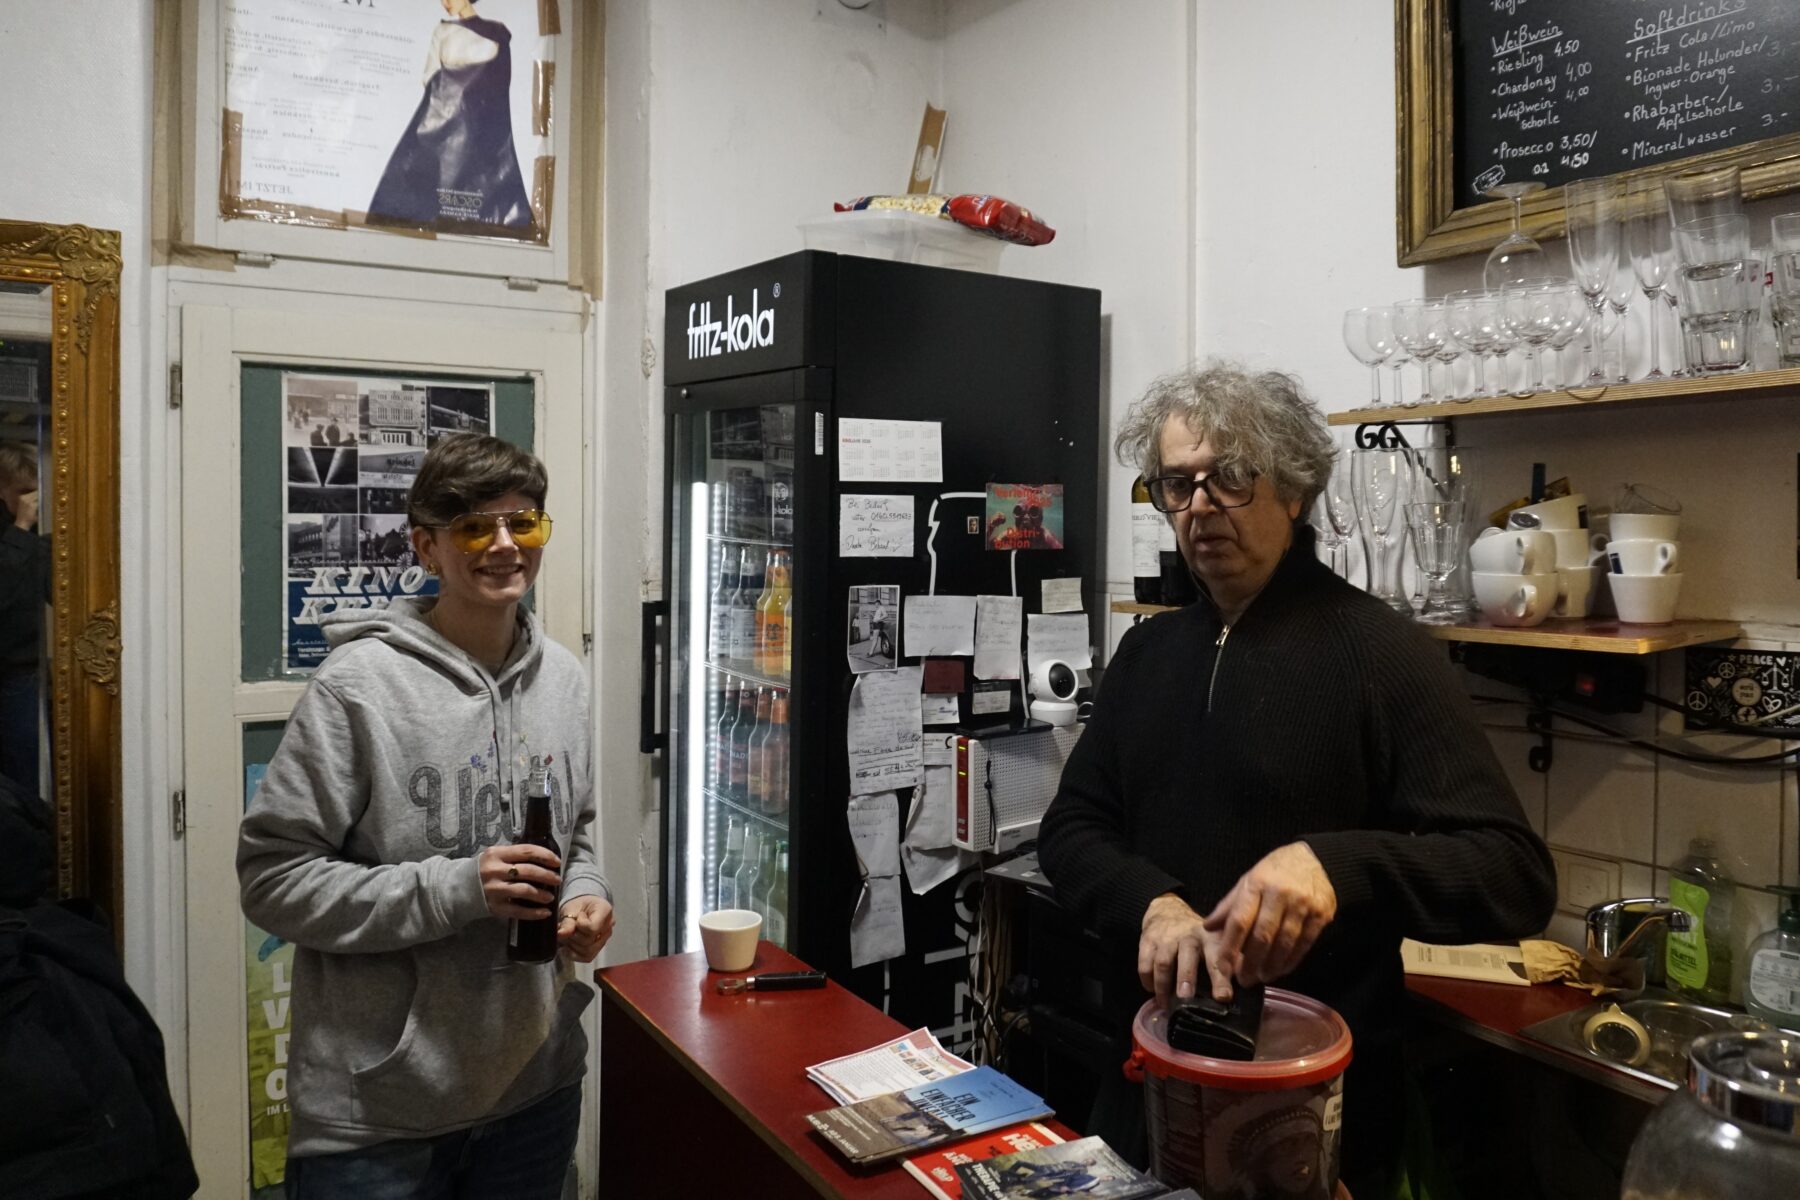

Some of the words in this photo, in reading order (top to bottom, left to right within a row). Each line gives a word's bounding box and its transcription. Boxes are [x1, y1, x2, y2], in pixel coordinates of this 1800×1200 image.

[1492, 20, 1561, 54] Weißwein
[1634, 42, 1670, 62] Fritz
[1679, 20, 1755, 48] Cola/Limo
[1498, 51, 1543, 74] Riesling
[1633, 56, 1691, 86] Bionade
[1498, 75, 1557, 96] Chardonay
[1499, 97, 1557, 121] Weißwein-
[1657, 96, 1744, 130] Apfelschorle
[1500, 141, 1554, 159] Prosecco
[687, 288, 774, 360] fritz-kola
[303, 565, 427, 595] KINO
[1740, 654, 1774, 666] PEACE
[919, 1088, 977, 1122] EINFACHER
